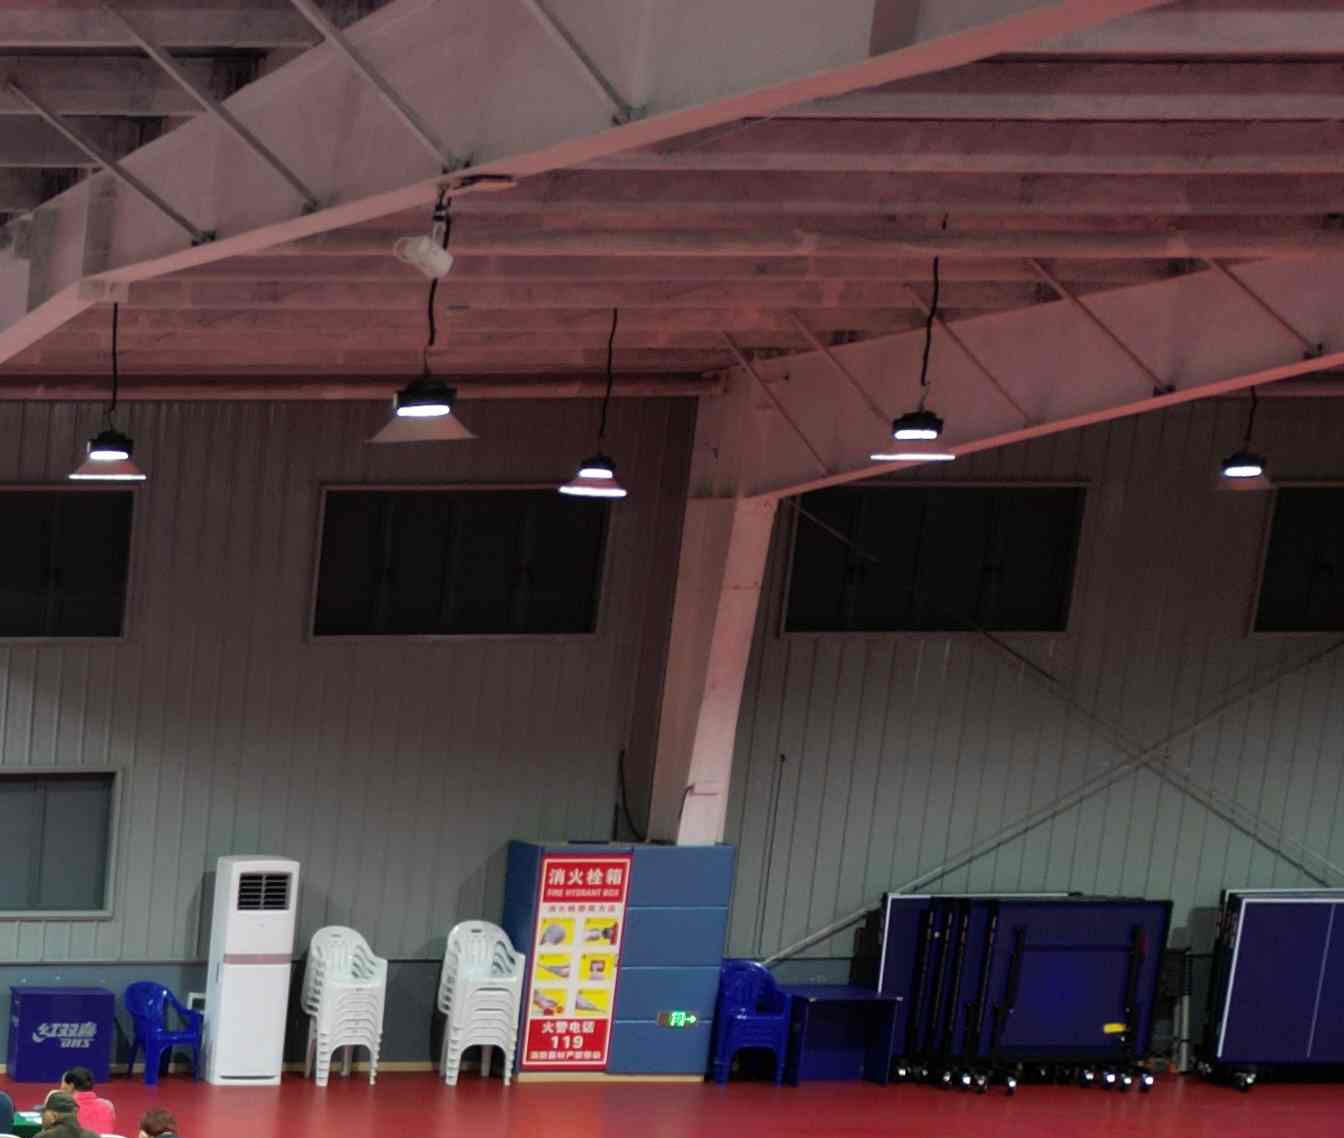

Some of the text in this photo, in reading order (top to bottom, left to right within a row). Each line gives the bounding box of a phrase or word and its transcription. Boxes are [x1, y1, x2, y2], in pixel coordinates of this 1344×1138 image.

[548, 867, 623, 885] 消火栓箱
[541, 1021, 595, 1034] 火警电话
[550, 1035, 584, 1049] 119
